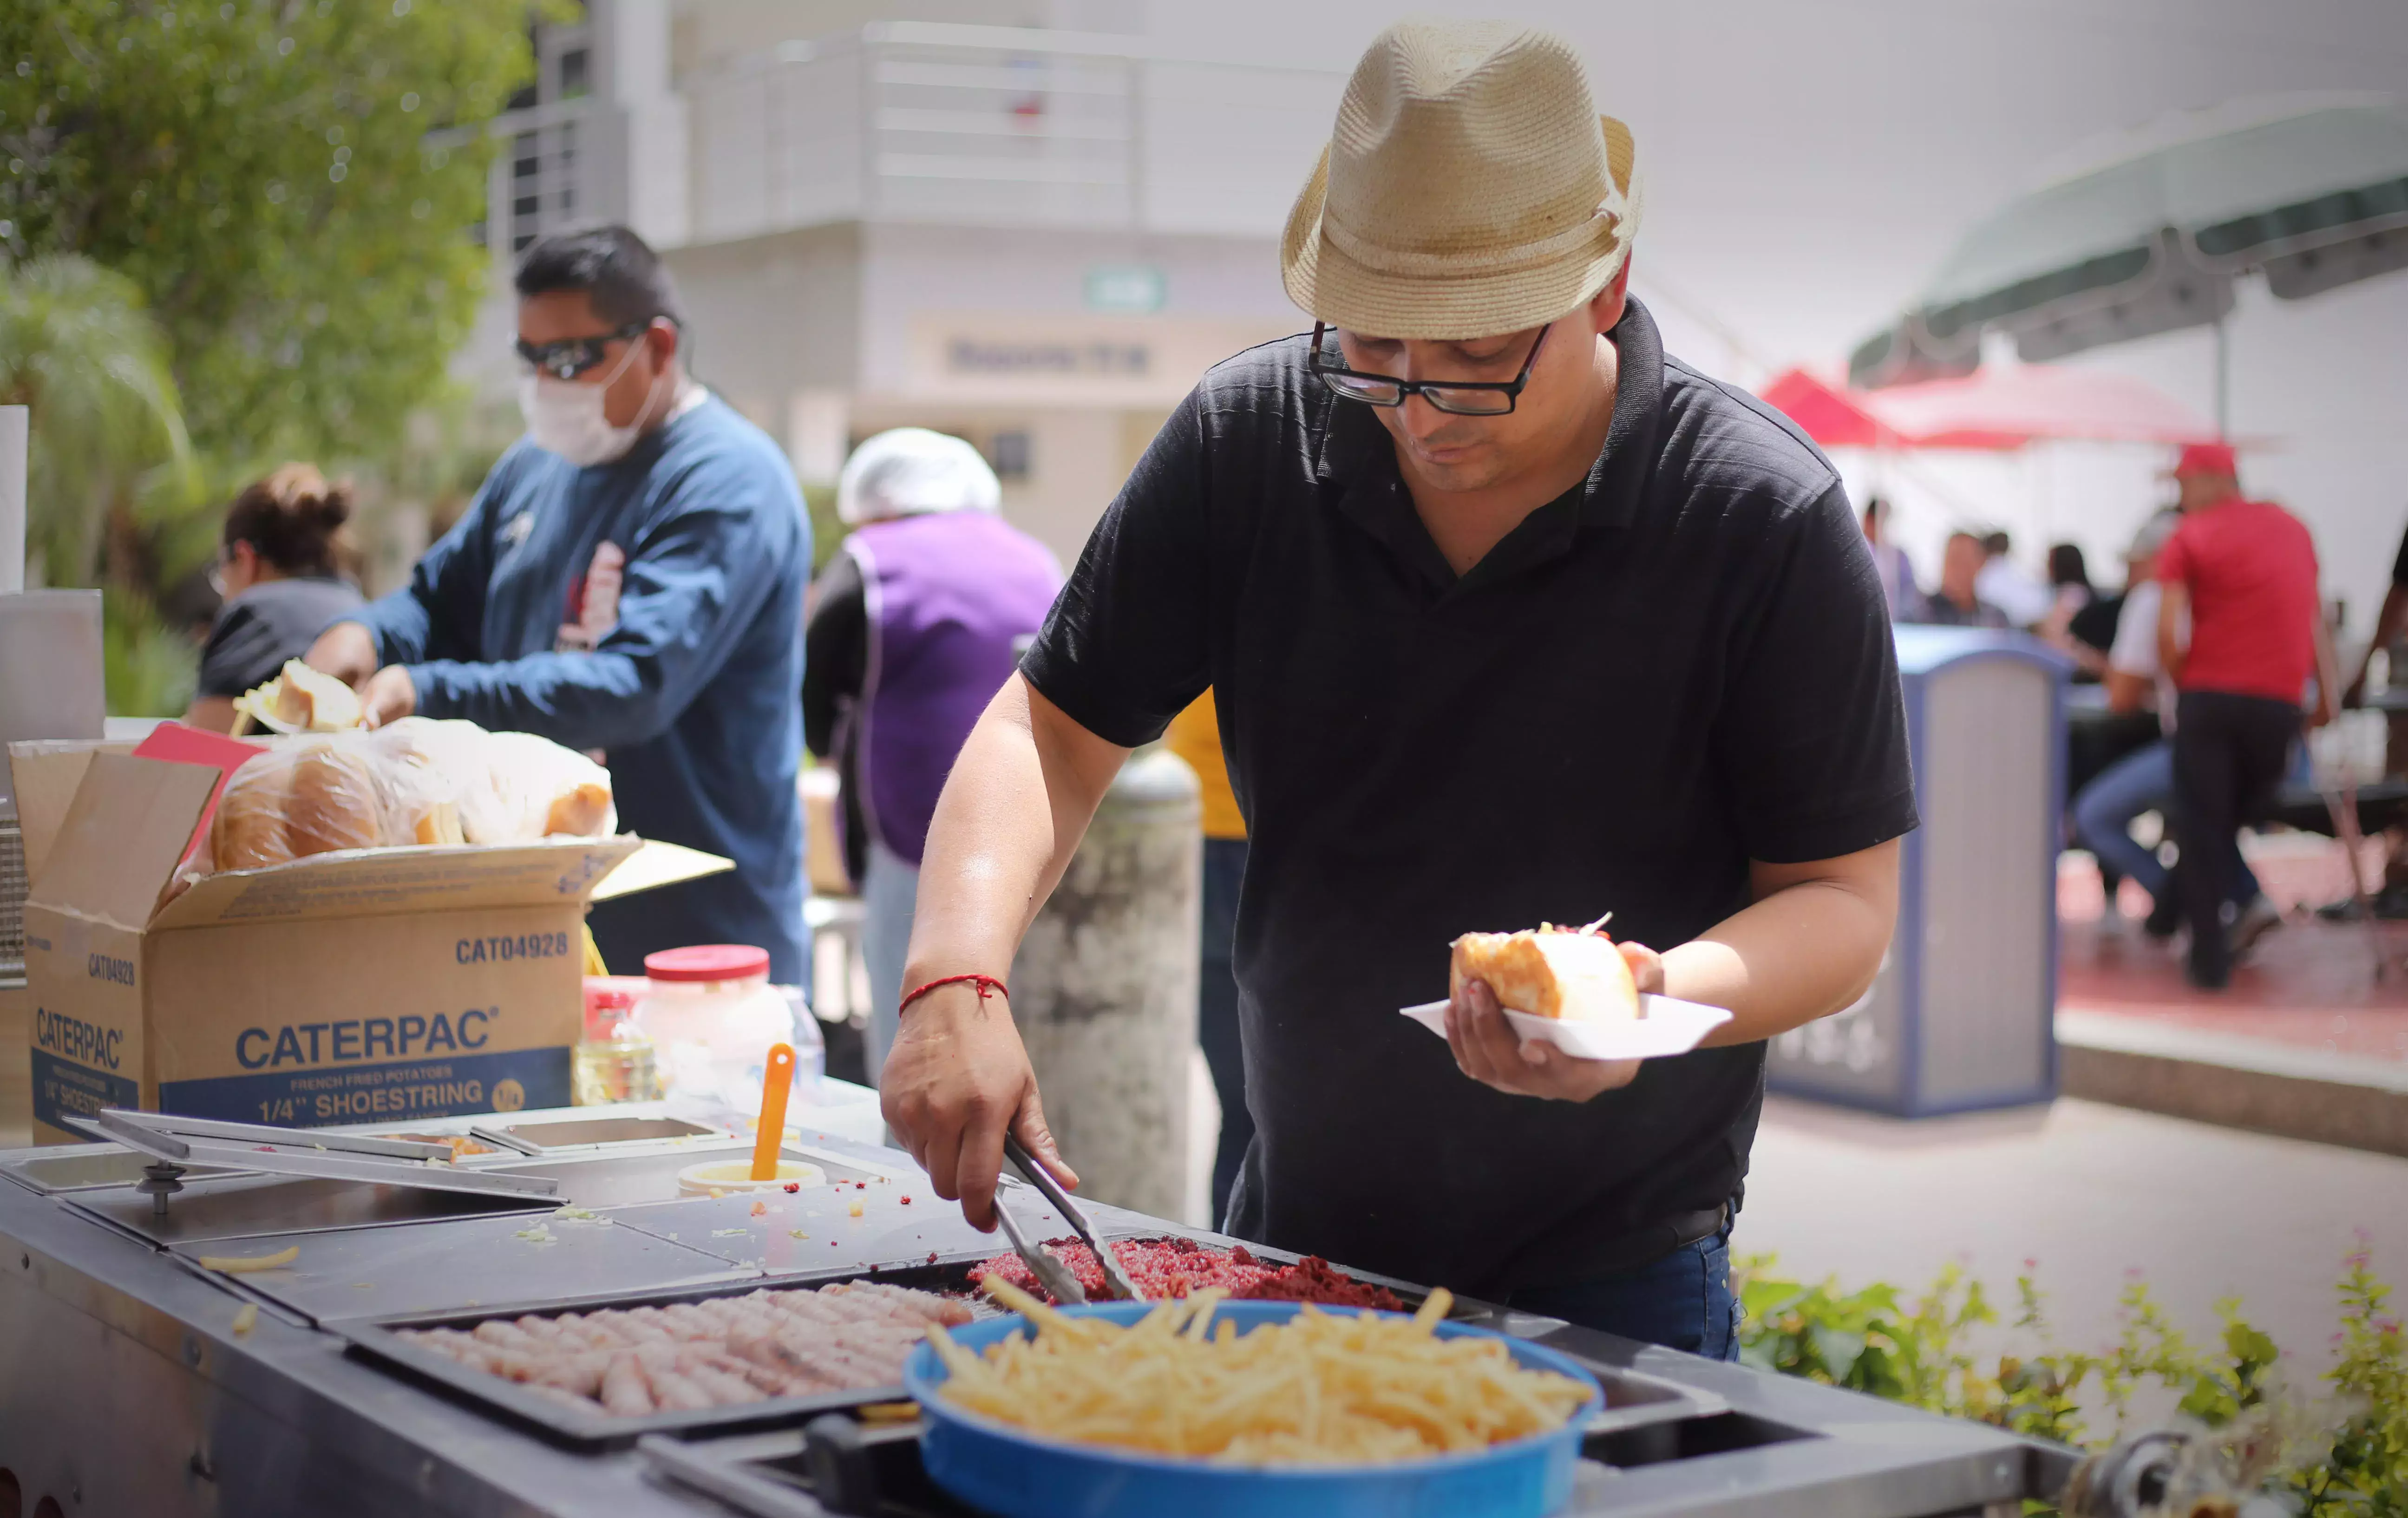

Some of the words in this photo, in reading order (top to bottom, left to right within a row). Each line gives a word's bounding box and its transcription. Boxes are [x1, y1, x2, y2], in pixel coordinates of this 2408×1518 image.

[456, 932, 568, 964] CAT04928
[88, 952, 135, 987] CAT04928
[236, 1009, 489, 1069] CATERPAC
[291, 1074, 343, 1091] FRENCH
[346, 1070, 383, 1087] FRIED
[385, 1064, 453, 1082] POTATOES
[315, 1079, 483, 1119] SHOESTRING
